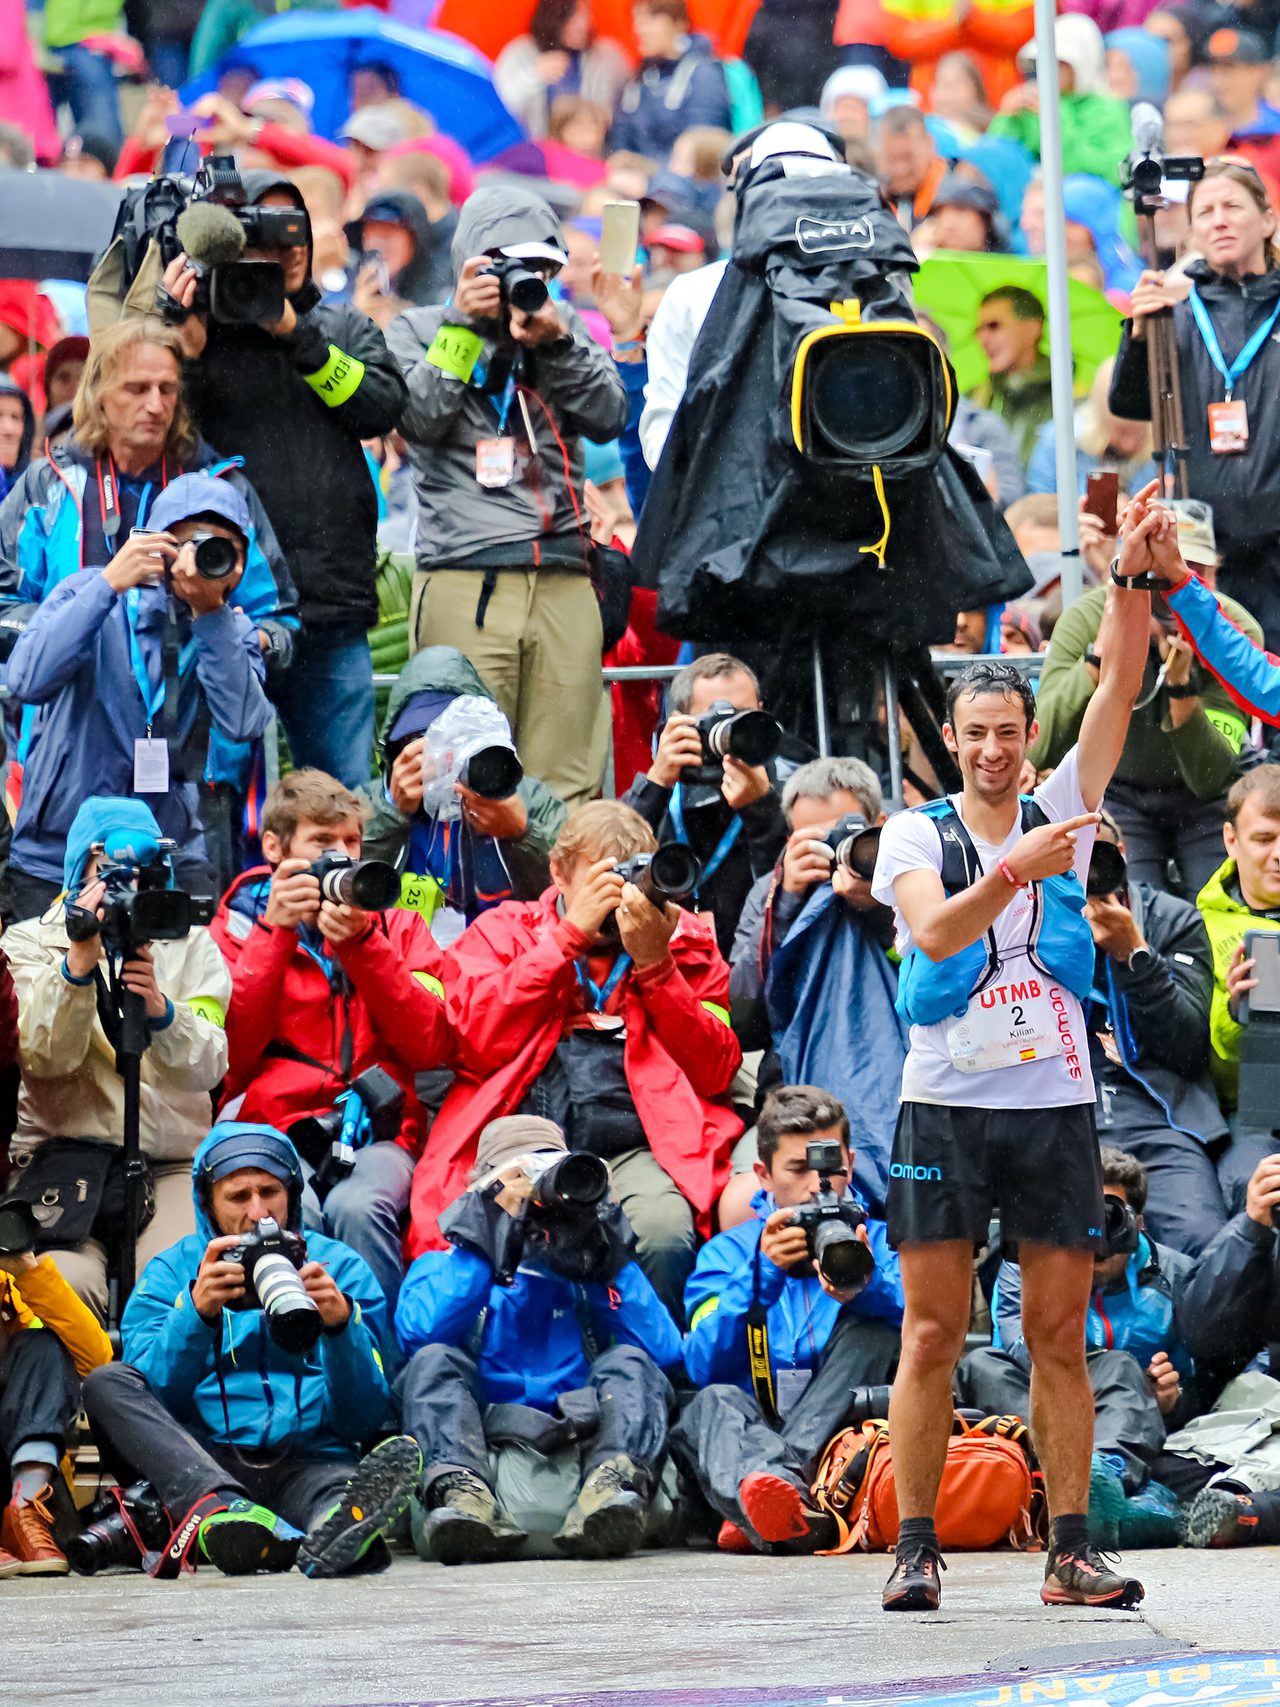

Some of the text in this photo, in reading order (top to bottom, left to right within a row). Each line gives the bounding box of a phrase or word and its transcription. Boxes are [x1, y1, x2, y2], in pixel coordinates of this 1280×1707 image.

[406, 888, 422, 906] 25
[980, 979, 1041, 1009] UTMB
[1011, 1005, 1026, 1026] 2
[1009, 1027, 1035, 1039] Kilian
[890, 1163, 942, 1181] omon
[169, 1513, 202, 1559] Canon
